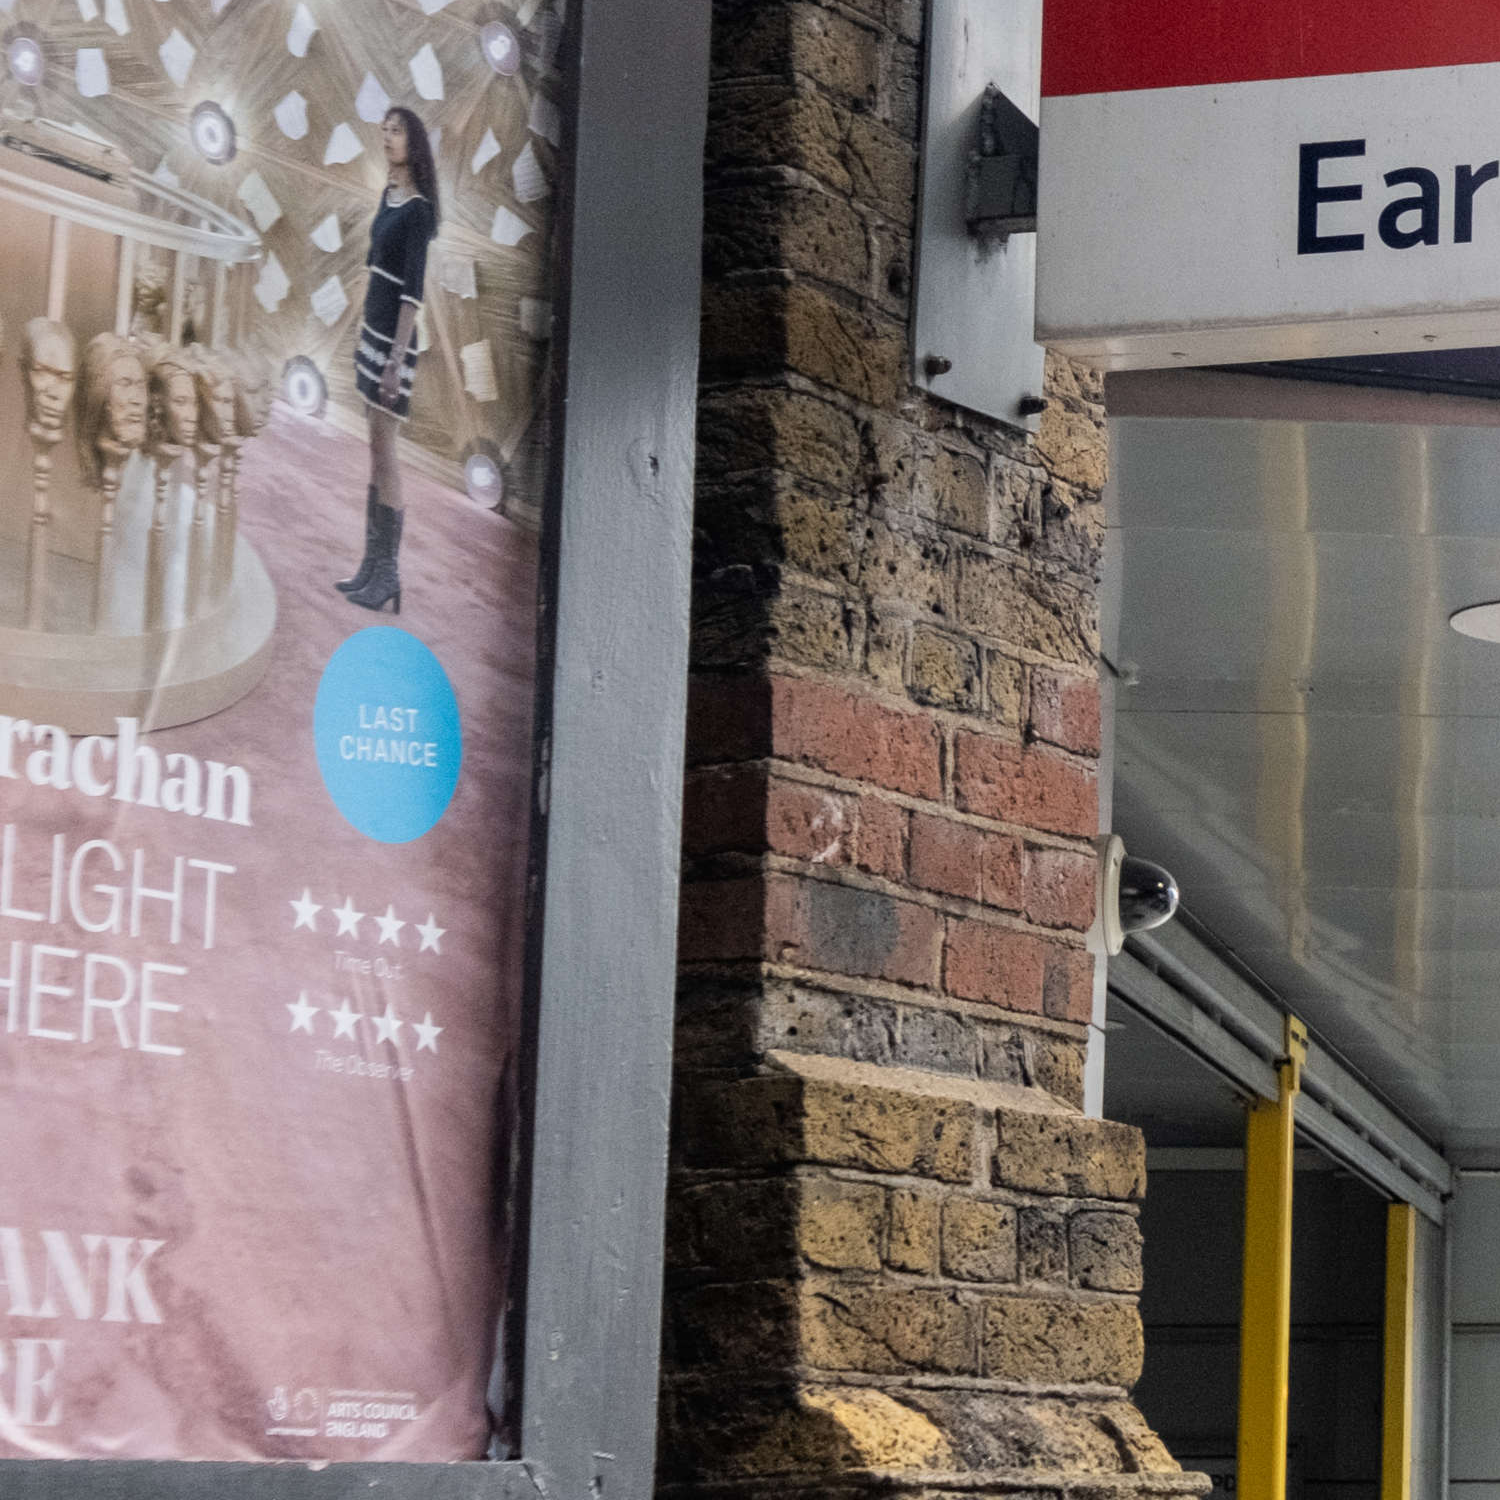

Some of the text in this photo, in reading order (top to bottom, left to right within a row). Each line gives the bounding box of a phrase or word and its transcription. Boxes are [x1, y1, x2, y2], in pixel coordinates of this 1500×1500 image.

[359, 703, 419, 733] LAST
[339, 735, 438, 767] CHANCE
[0, 823, 237, 949] LIGHT
[327, 1402, 418, 1421] ARTS COUNCIL
[325, 1421, 389, 1438] ENGLAND
